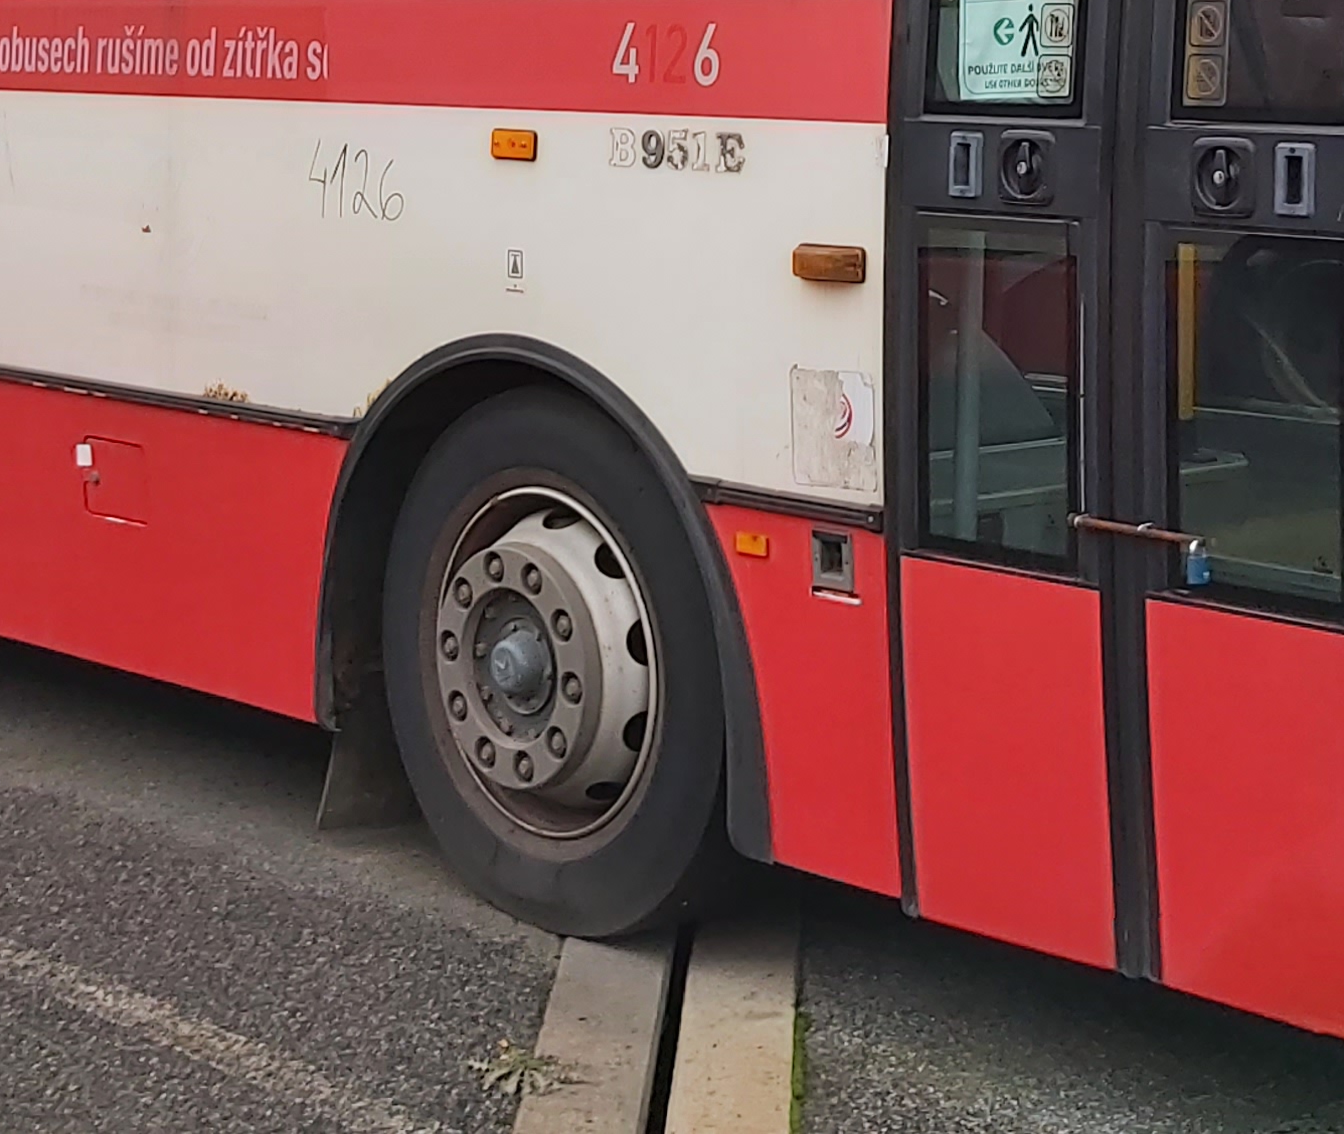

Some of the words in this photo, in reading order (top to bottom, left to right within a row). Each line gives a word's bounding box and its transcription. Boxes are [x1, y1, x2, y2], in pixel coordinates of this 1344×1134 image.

[95, 24, 180, 76] rušíme
[185, 26, 217, 78] od
[222, 25, 299, 81] zítřka
[308, 138, 405, 221] 4126
[609, 127, 746, 175] B951E
